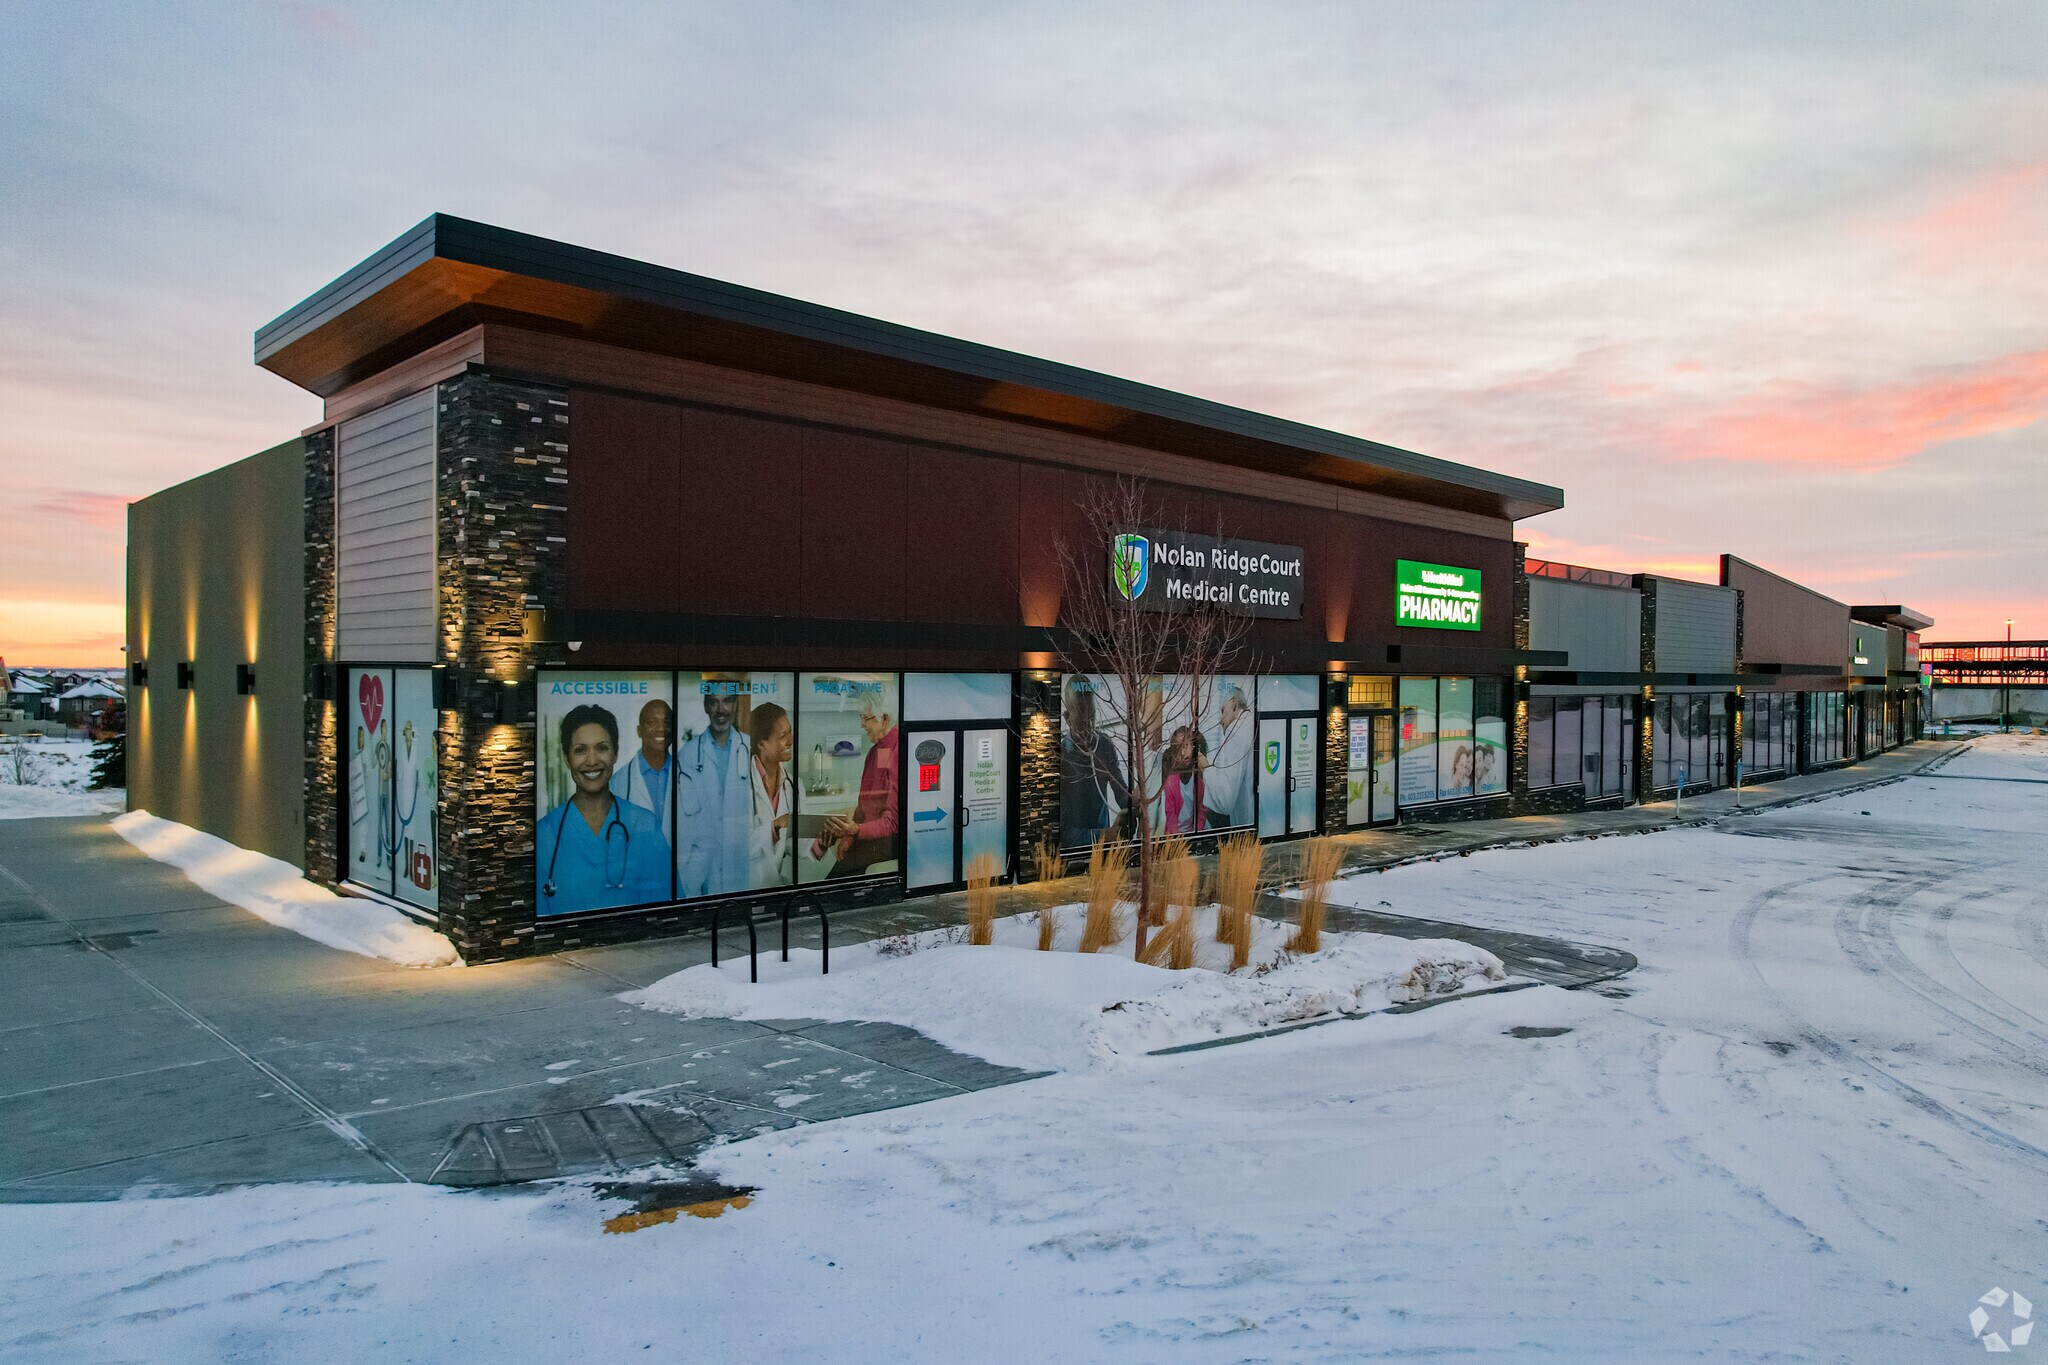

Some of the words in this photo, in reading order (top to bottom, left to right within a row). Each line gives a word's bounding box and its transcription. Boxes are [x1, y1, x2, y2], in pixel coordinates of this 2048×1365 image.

[1153, 542, 1205, 568] Nolan
[1211, 548, 1301, 577] RidgeCourt
[1166, 577, 1233, 603] Medical
[1238, 583, 1290, 607] Centre
[1399, 594, 1479, 624] PHARMACY
[551, 682, 648, 695] ACCESSIBLE
[700, 682, 777, 695] EXCELLENT
[814, 682, 882, 694] PROACTIVE
[1217, 682, 1236, 692] CARE
